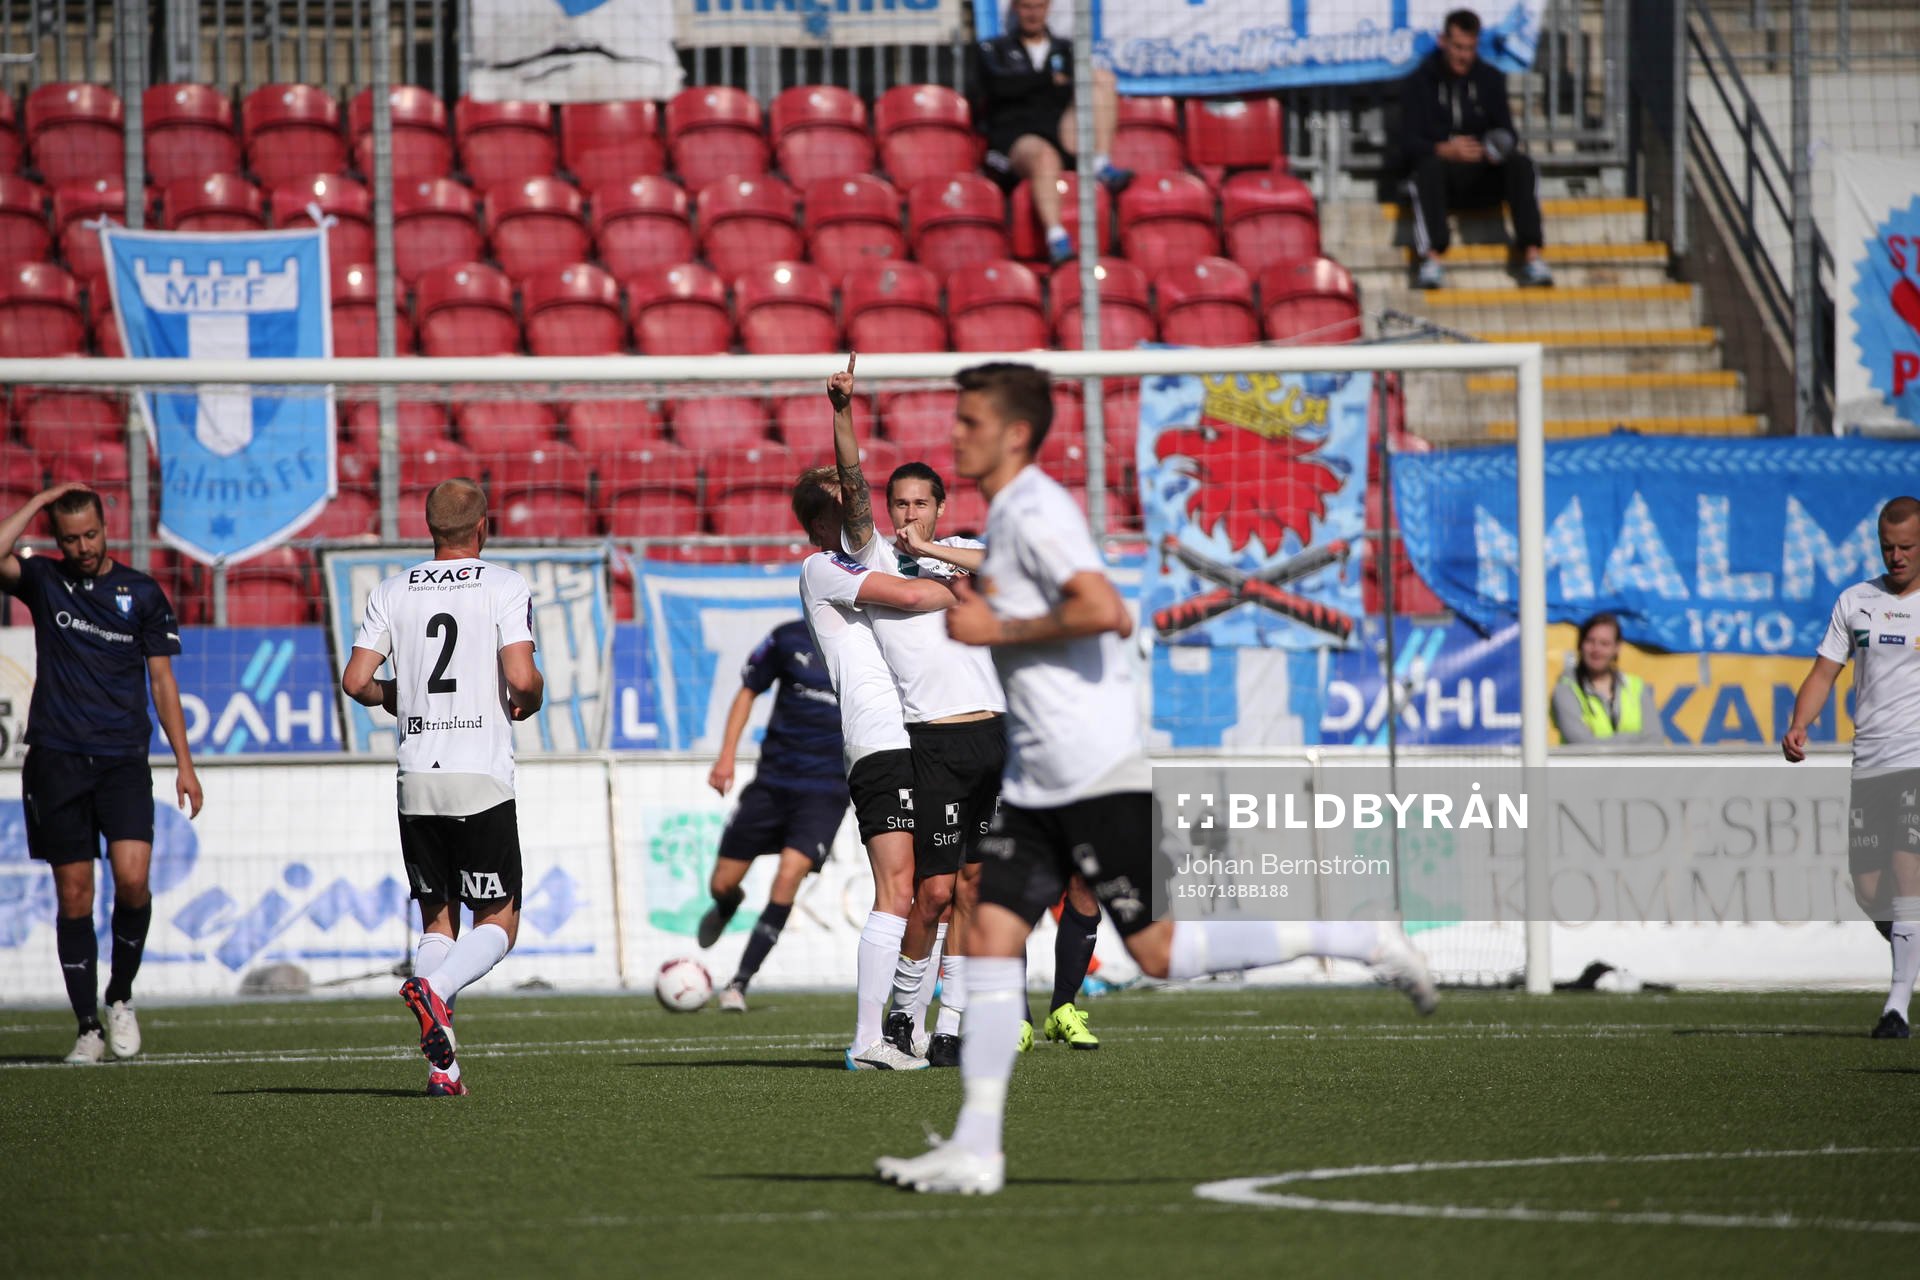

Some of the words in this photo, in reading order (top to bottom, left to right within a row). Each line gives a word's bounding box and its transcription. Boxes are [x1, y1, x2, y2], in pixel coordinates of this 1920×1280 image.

[273, 447, 317, 492] FF
[408, 566, 485, 585] EXACT
[408, 584, 435, 592] Passion
[437, 583, 448, 592] for
[449, 581, 482, 592] precision
[426, 612, 458, 694] 2
[1686, 607, 1794, 654] 1910
[158, 690, 341, 746] DAH
[460, 869, 507, 899] NA
